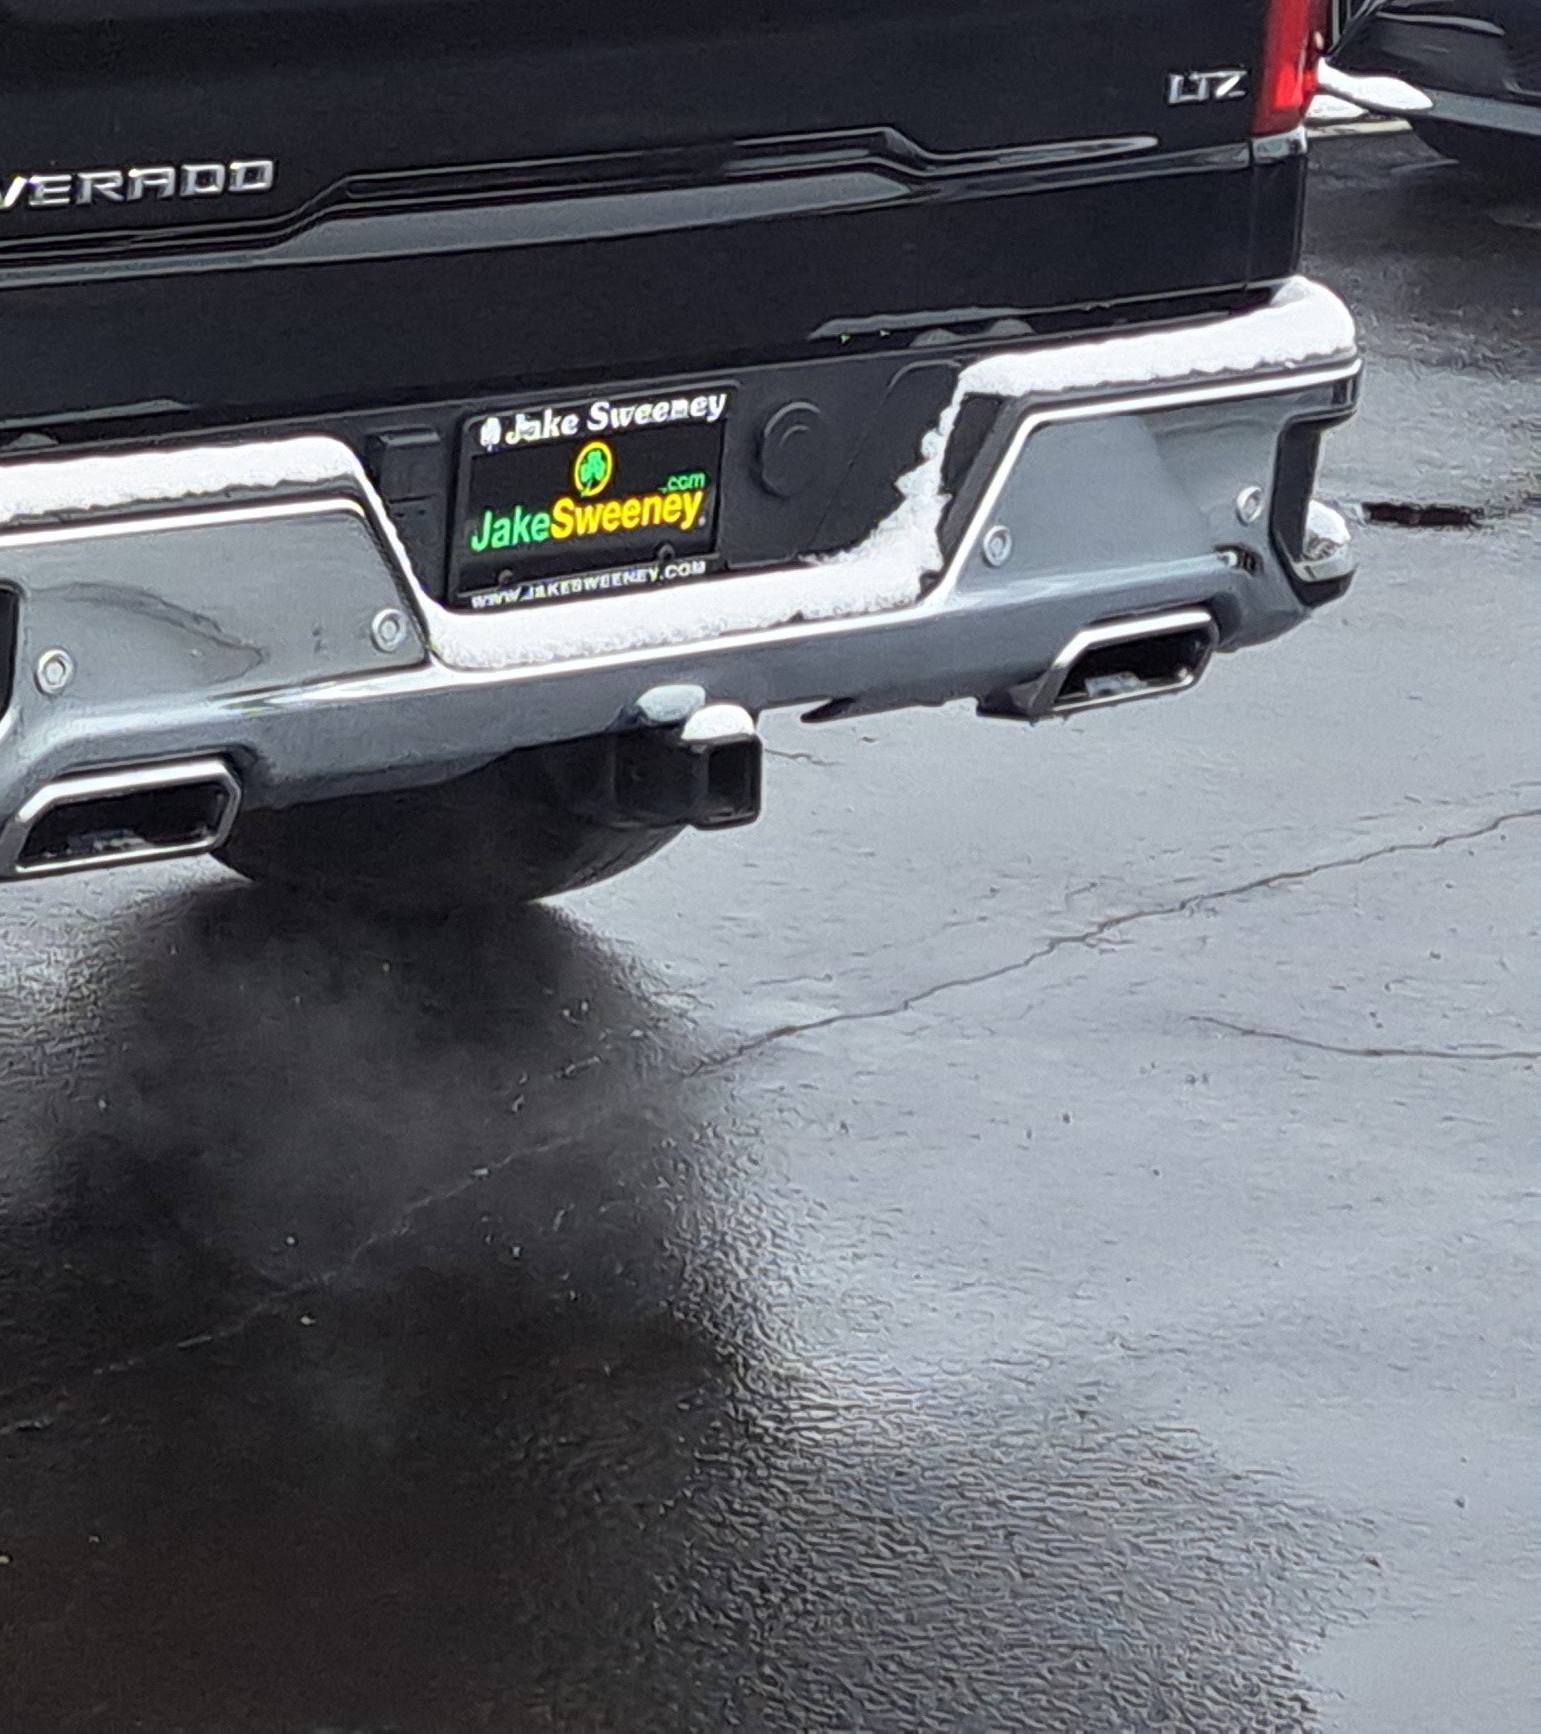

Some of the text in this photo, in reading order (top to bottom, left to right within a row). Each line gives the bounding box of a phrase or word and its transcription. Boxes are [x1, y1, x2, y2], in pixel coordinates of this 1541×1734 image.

[1167, 69, 1248, 104] LTZ
[505, 392, 728, 446] Jake Sweeney
